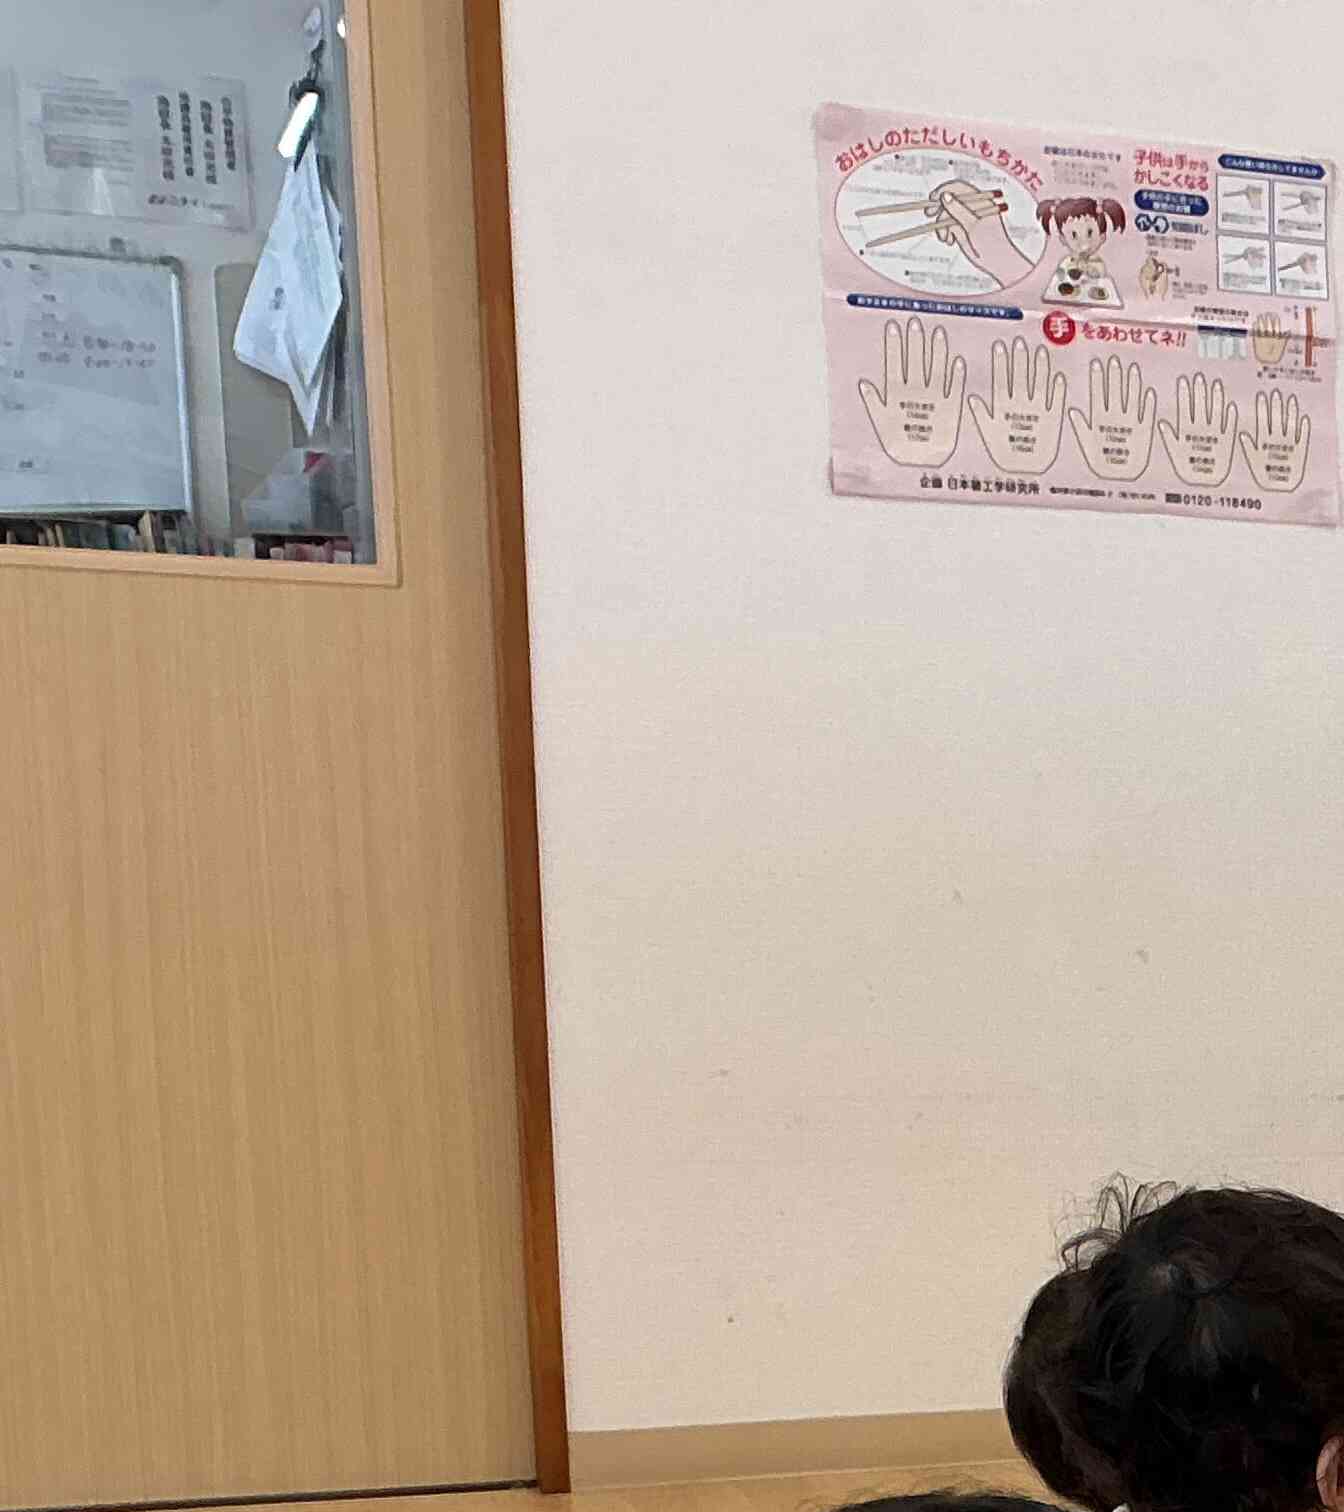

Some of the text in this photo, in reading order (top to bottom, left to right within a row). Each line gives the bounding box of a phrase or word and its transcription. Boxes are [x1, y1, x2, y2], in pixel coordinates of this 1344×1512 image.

[835, 127, 1043, 191] おはしのただしいもちかた
[1134, 150, 1209, 172] 子供は手から
[1134, 169, 1209, 191] かしこくなる
